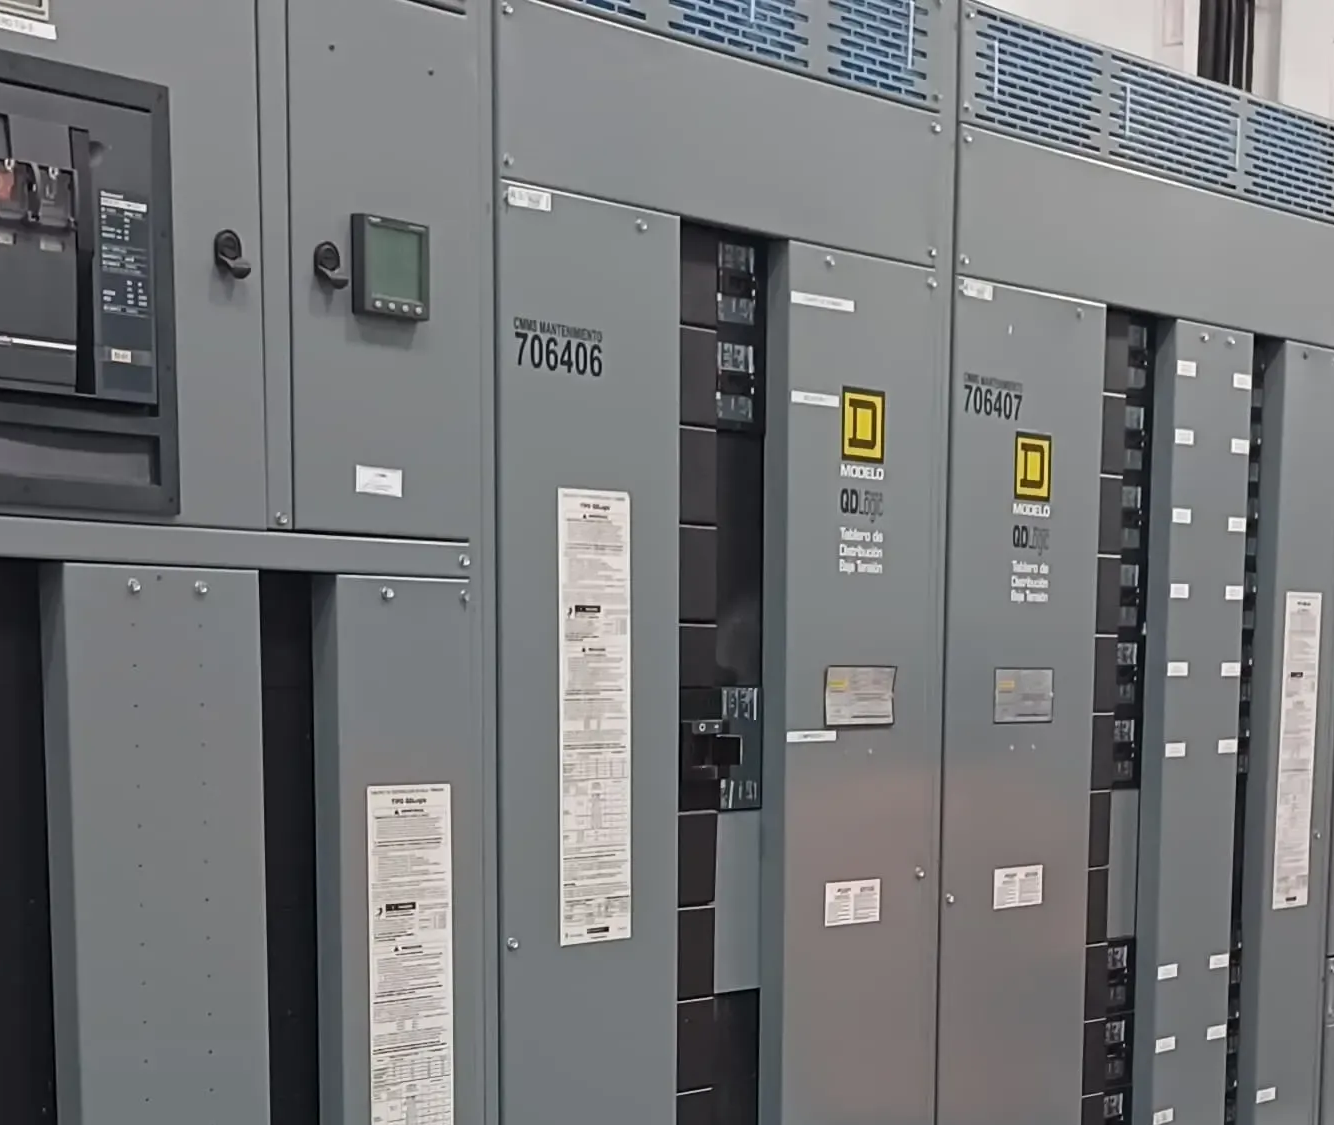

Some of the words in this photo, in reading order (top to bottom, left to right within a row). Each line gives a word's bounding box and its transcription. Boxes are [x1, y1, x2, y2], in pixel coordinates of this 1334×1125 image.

[515, 331, 602, 377] 706406
[964, 384, 1023, 421] 706407
[840, 463, 884, 482] MODELO
[1012, 502, 1050, 517] MODELO
